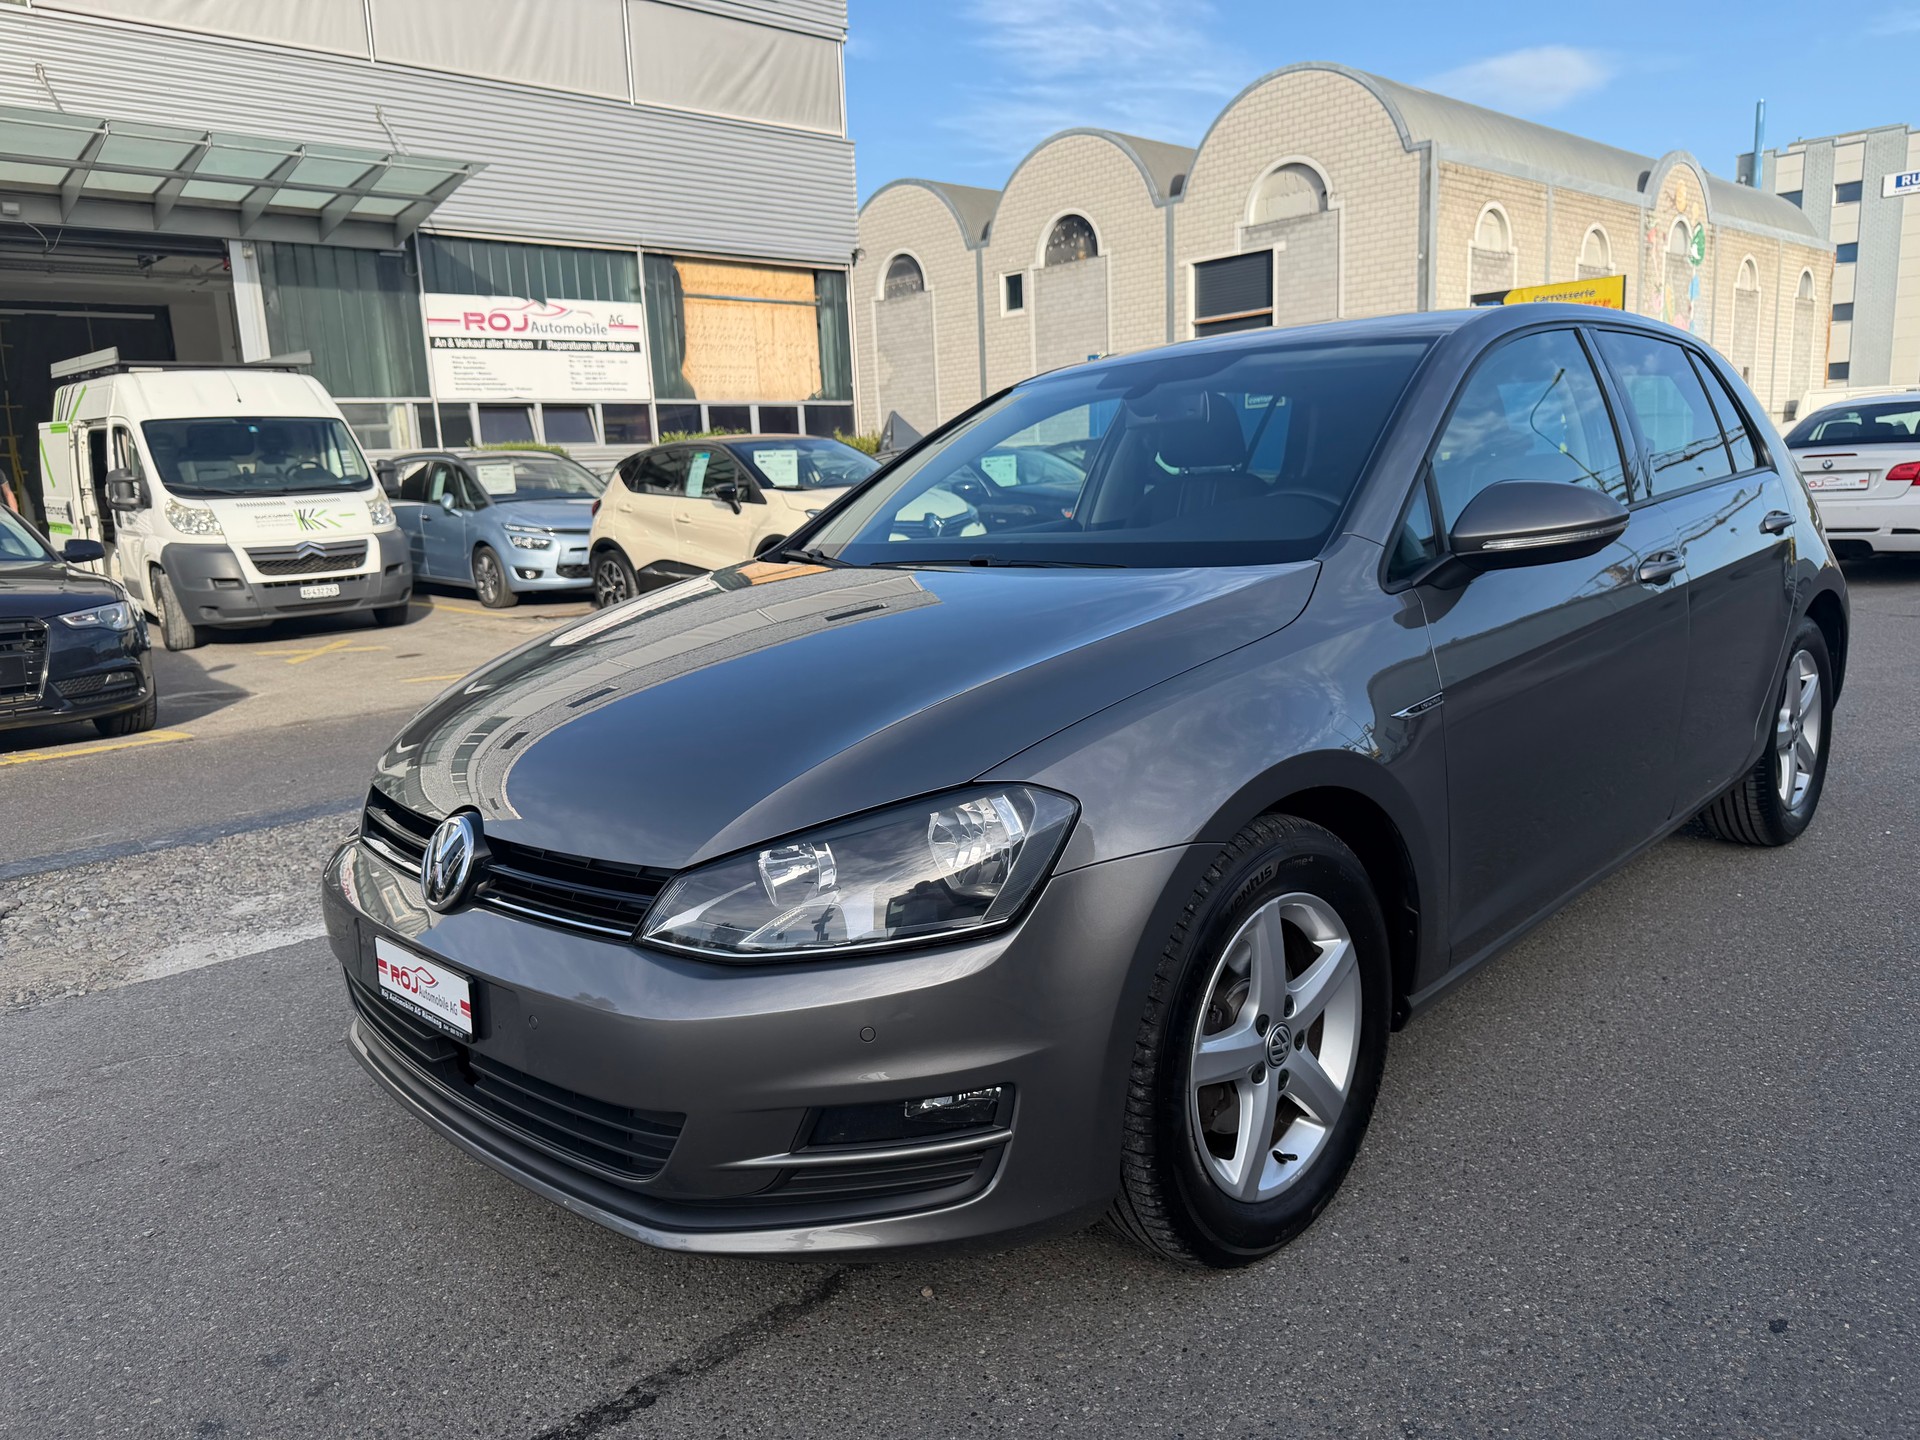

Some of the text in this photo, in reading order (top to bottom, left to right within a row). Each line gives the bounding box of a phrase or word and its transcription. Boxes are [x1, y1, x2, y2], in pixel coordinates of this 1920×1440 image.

[1534, 289, 1595, 302] Carrosserie
[463, 312, 624, 335] ROJ Automobile AG
[434, 337, 447, 348] An
[447, 338, 455, 348] &
[455, 338, 486, 349] Verkauf
[486, 339, 504, 349] aller
[504, 340, 533, 350] Marken
[546, 340, 591, 352] Reparaturen
[591, 341, 608, 351] aller
[608, 342, 634, 352] Marken
[390, 964, 458, 1016] ROJ Automobile AG
